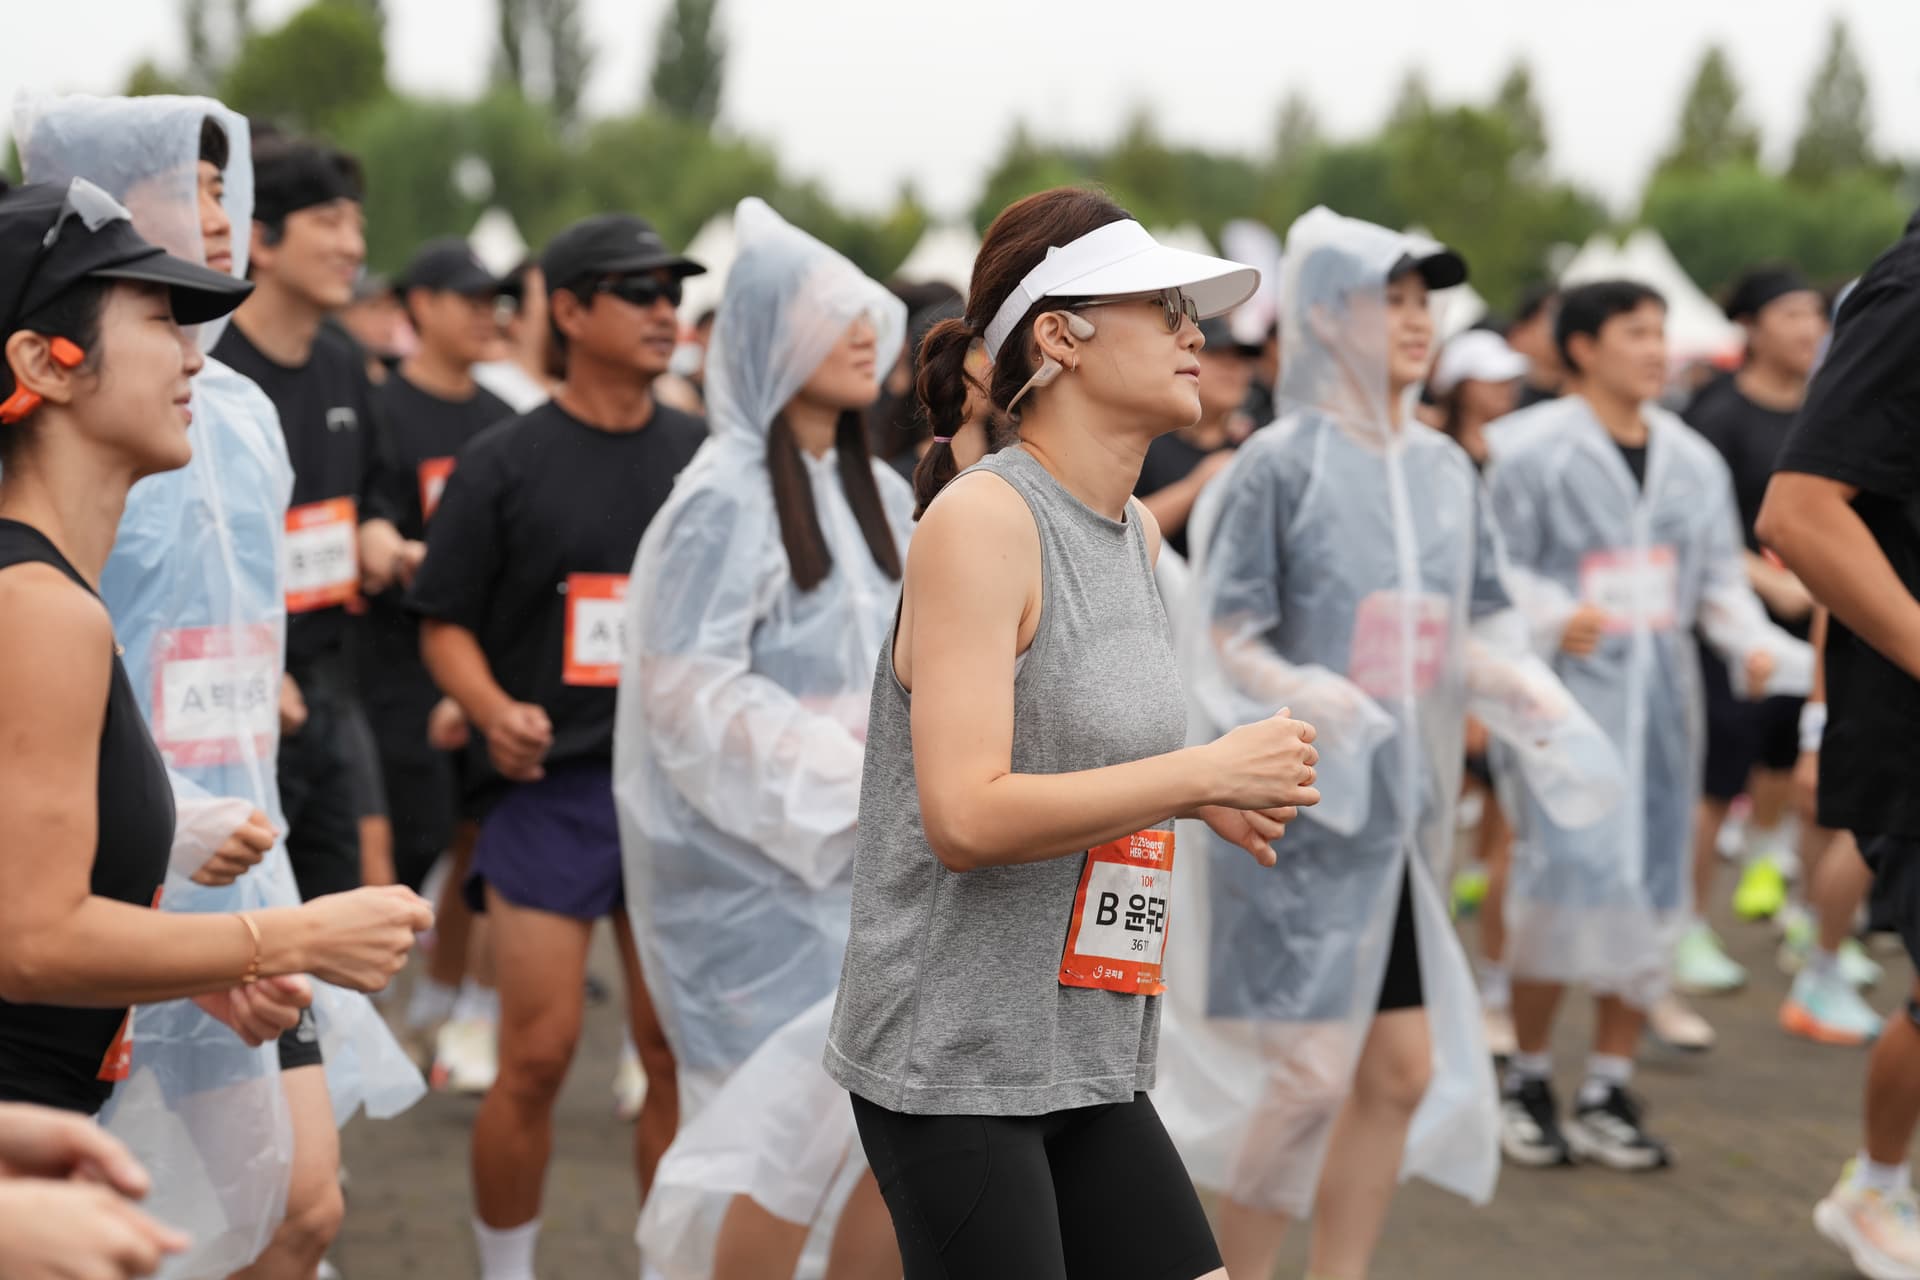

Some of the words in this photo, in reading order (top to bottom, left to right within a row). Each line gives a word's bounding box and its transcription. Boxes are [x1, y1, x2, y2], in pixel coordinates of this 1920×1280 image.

[588, 618, 612, 641] A
[180, 683, 207, 713] A
[1096, 891, 1119, 926] B
